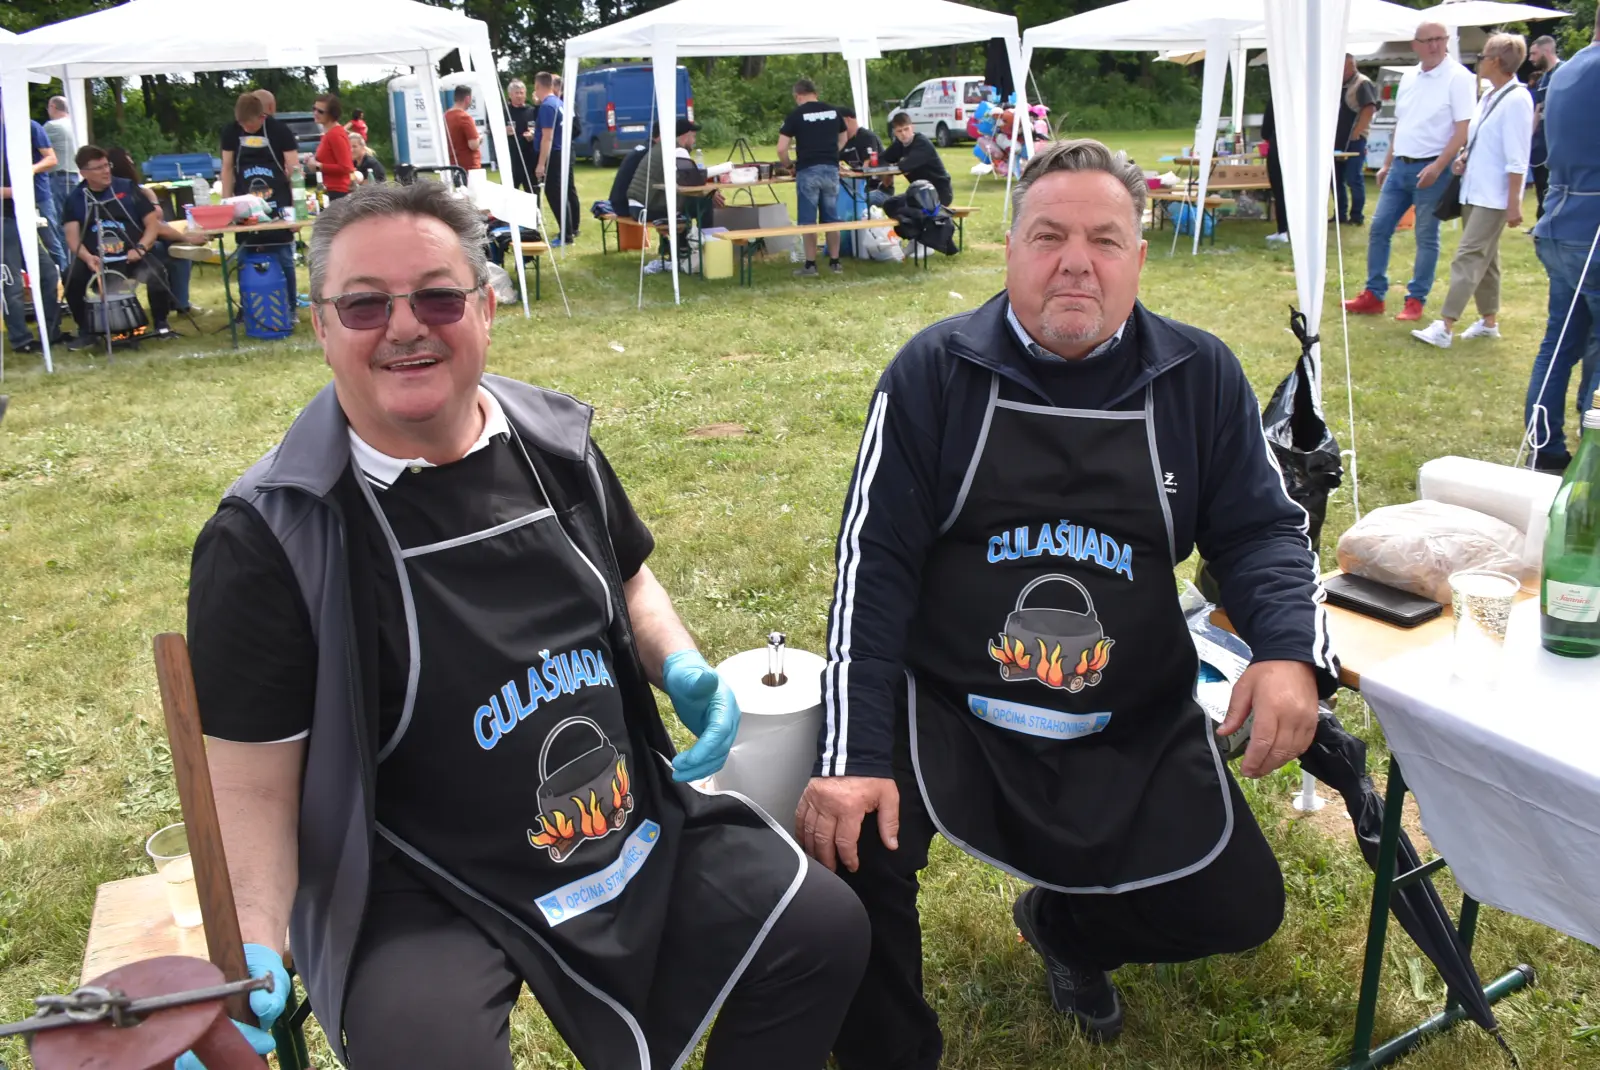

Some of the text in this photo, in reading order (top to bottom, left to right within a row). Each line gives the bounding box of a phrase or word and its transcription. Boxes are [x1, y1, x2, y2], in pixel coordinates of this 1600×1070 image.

[986, 519, 1134, 581] GULAŠIJADA
[473, 648, 615, 751] GULAŠIJADA
[992, 706, 1027, 725] OPĆINA
[565, 882, 606, 909] OPĆINA
